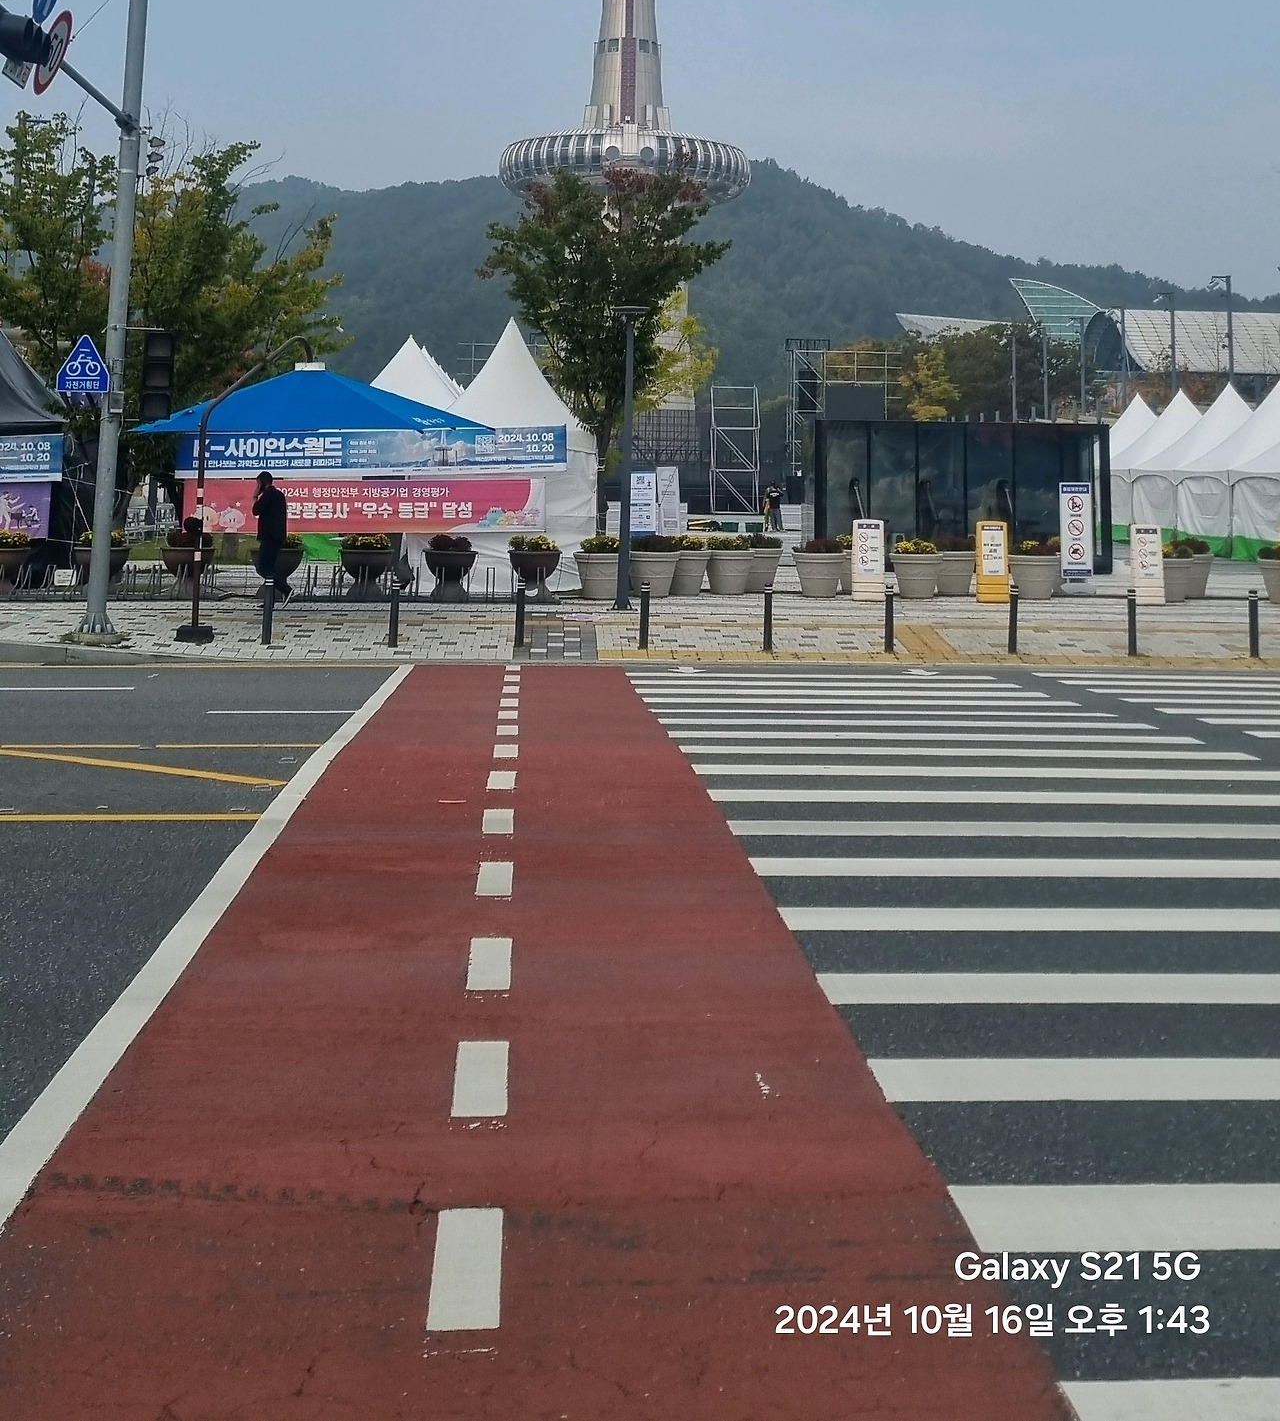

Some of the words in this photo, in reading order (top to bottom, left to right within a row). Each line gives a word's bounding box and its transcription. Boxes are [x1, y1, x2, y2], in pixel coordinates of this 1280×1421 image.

[65, 380, 99, 390] 자전거횡단
[499, 434, 524, 443] 2024.
[526, 434, 540, 442] 10.
[542, 433, 554, 441] 08
[37, 441, 51, 450] 08
[542, 443, 554, 451] 20
[37, 452, 50, 462] 20
[238, 459, 267, 468] 과학도시
[268, 459, 289, 467] 대전의
[290, 459, 312, 467] 새로운
[312, 487, 360, 498] 행정안전부
[362, 487, 408, 498] 지방공기업
[411, 487, 450, 498] 경영평가
[442, 501, 473, 519] 달성
